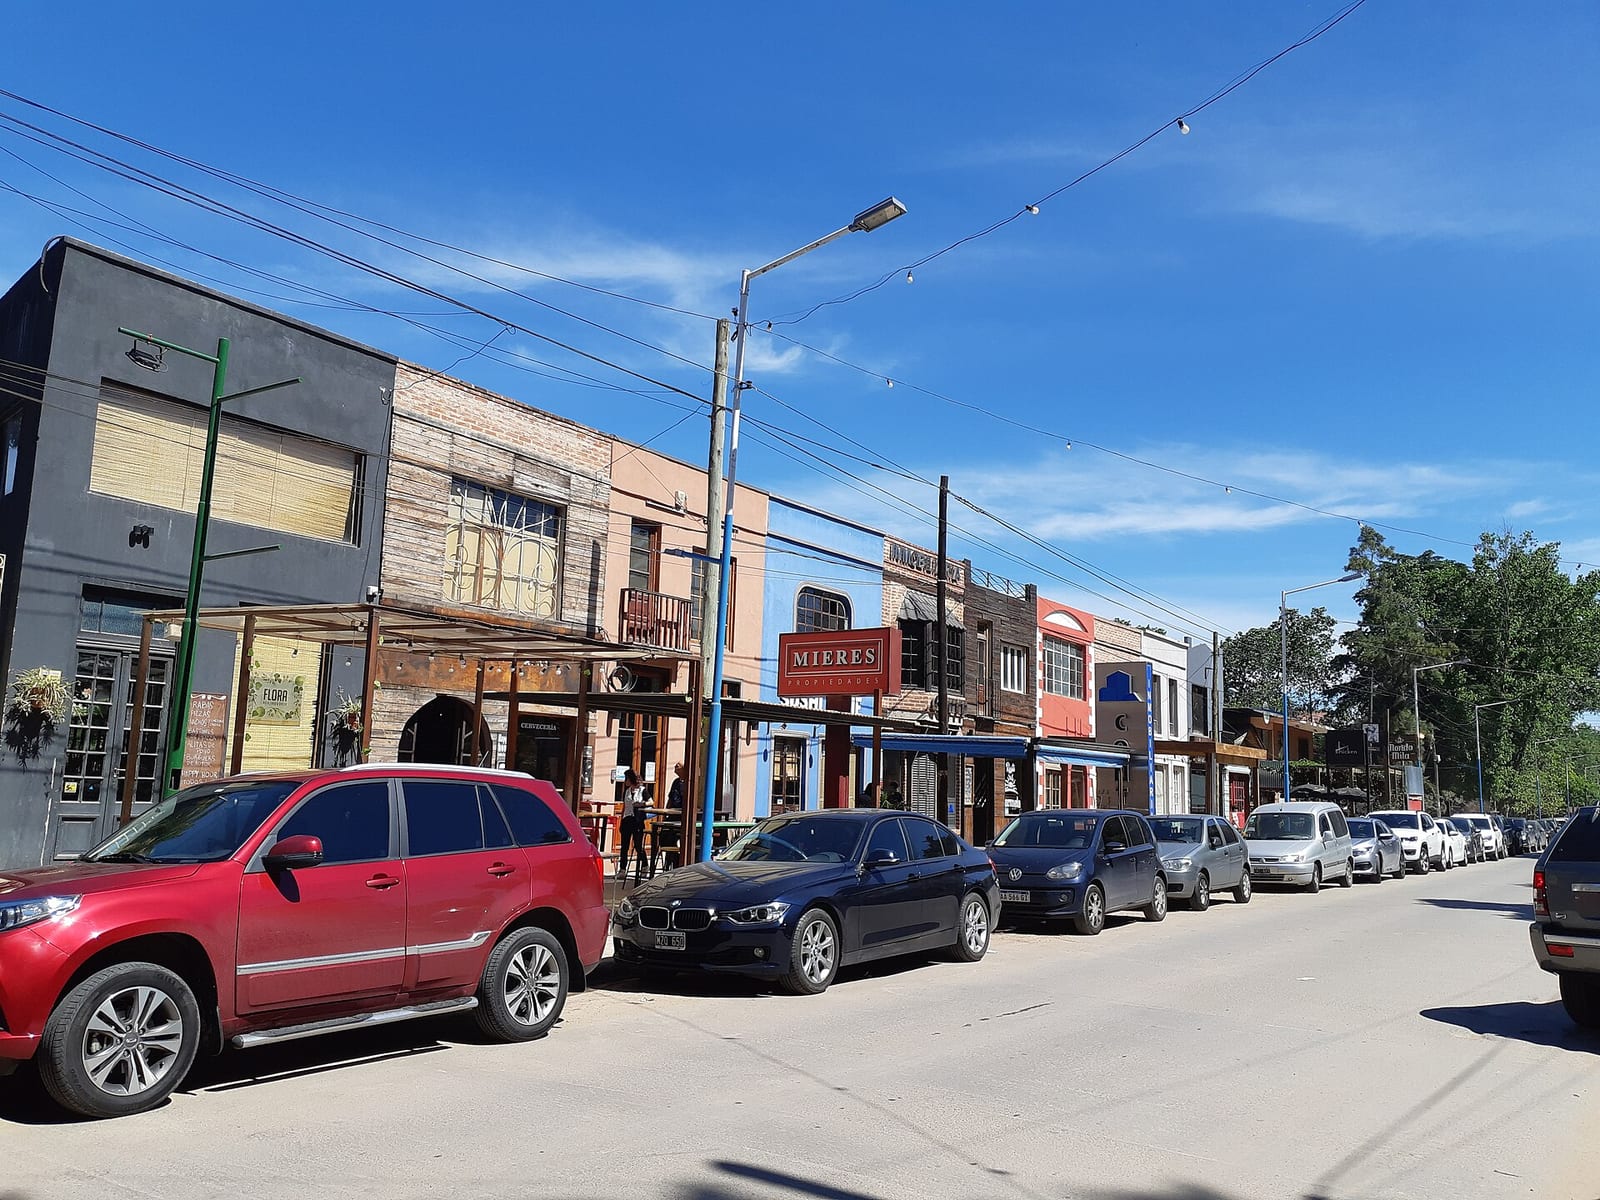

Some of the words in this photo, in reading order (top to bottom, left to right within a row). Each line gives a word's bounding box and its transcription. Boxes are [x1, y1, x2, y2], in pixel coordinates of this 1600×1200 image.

[793, 647, 876, 667] MIERES
[787, 677, 879, 687] PROPIEDADES
[263, 688, 288, 702] FLORA
